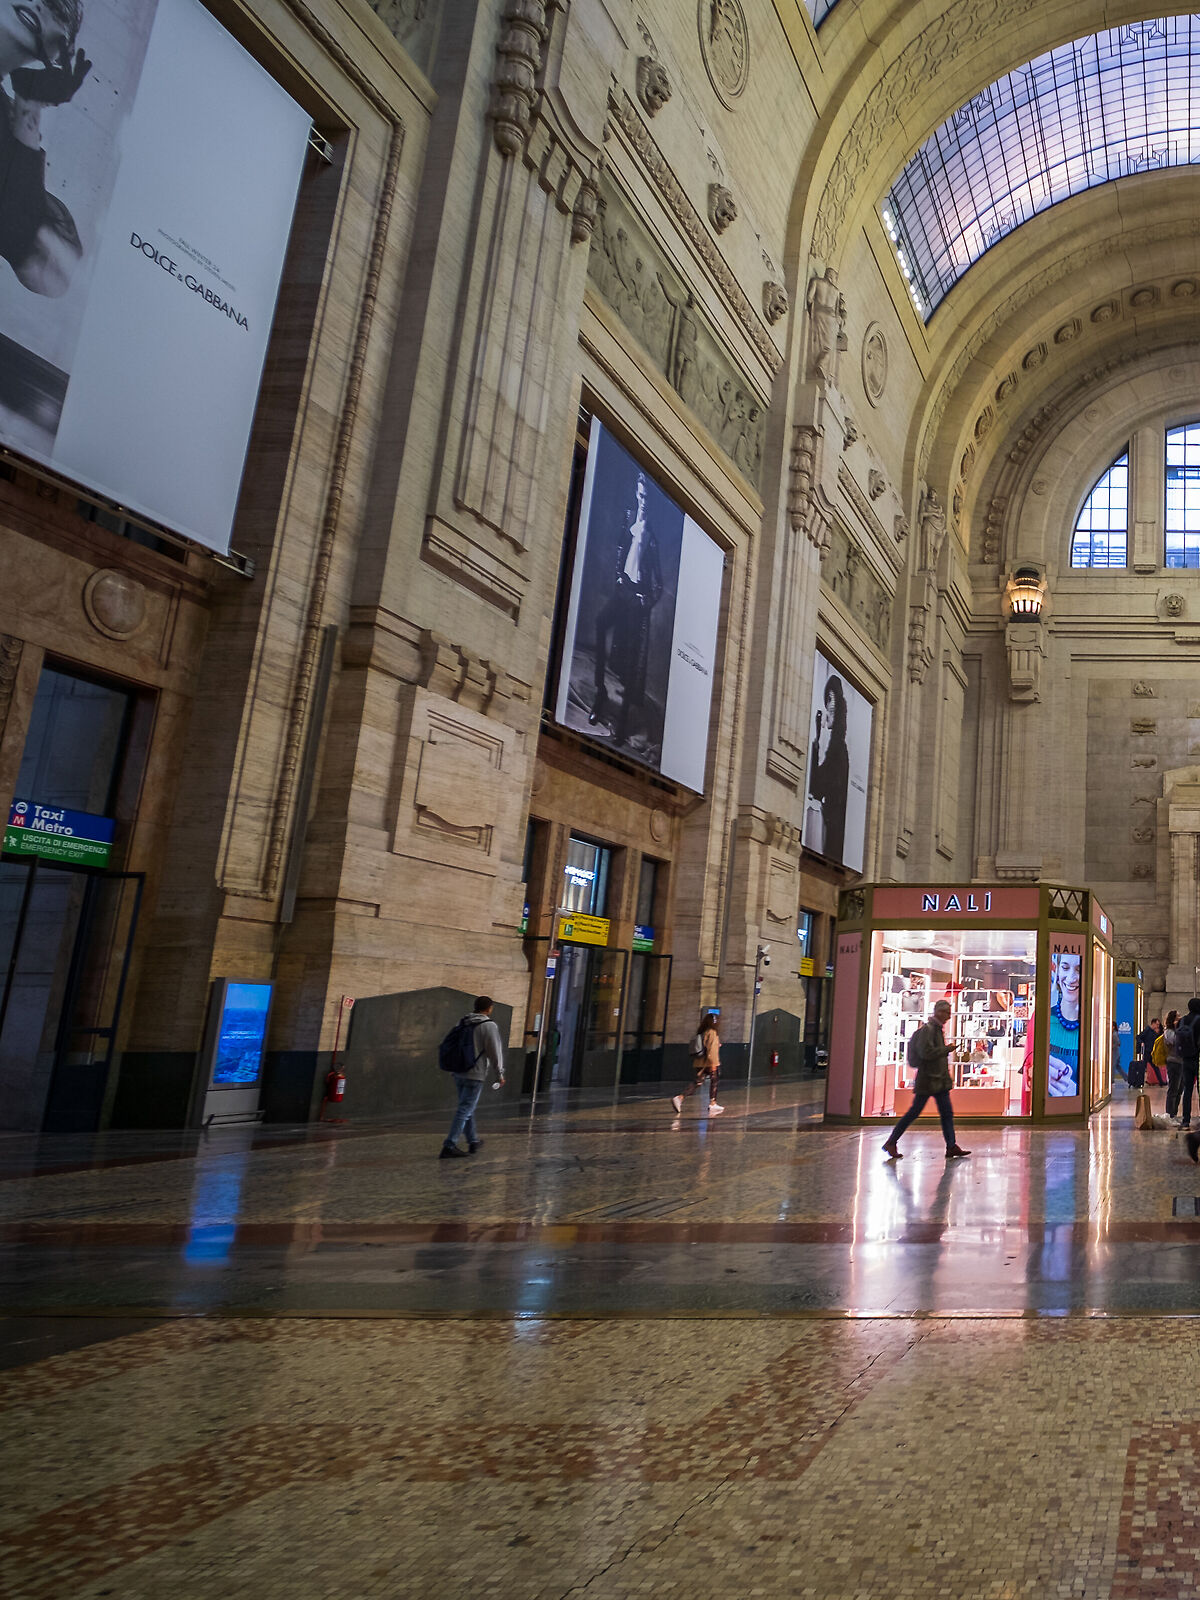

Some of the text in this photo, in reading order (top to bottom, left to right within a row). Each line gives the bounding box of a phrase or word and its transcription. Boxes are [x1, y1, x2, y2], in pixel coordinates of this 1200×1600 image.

[130, 232, 177, 277] DOLCE
[177, 273, 183, 282] &
[184, 274, 249, 331] GABBANA
[34, 805, 66, 822] Taxi
[31, 818, 74, 835] Metro
[20, 842, 85, 858] EMERGENCY EXIT
[22, 834, 108, 854] USCITA DI EMERGENZA
